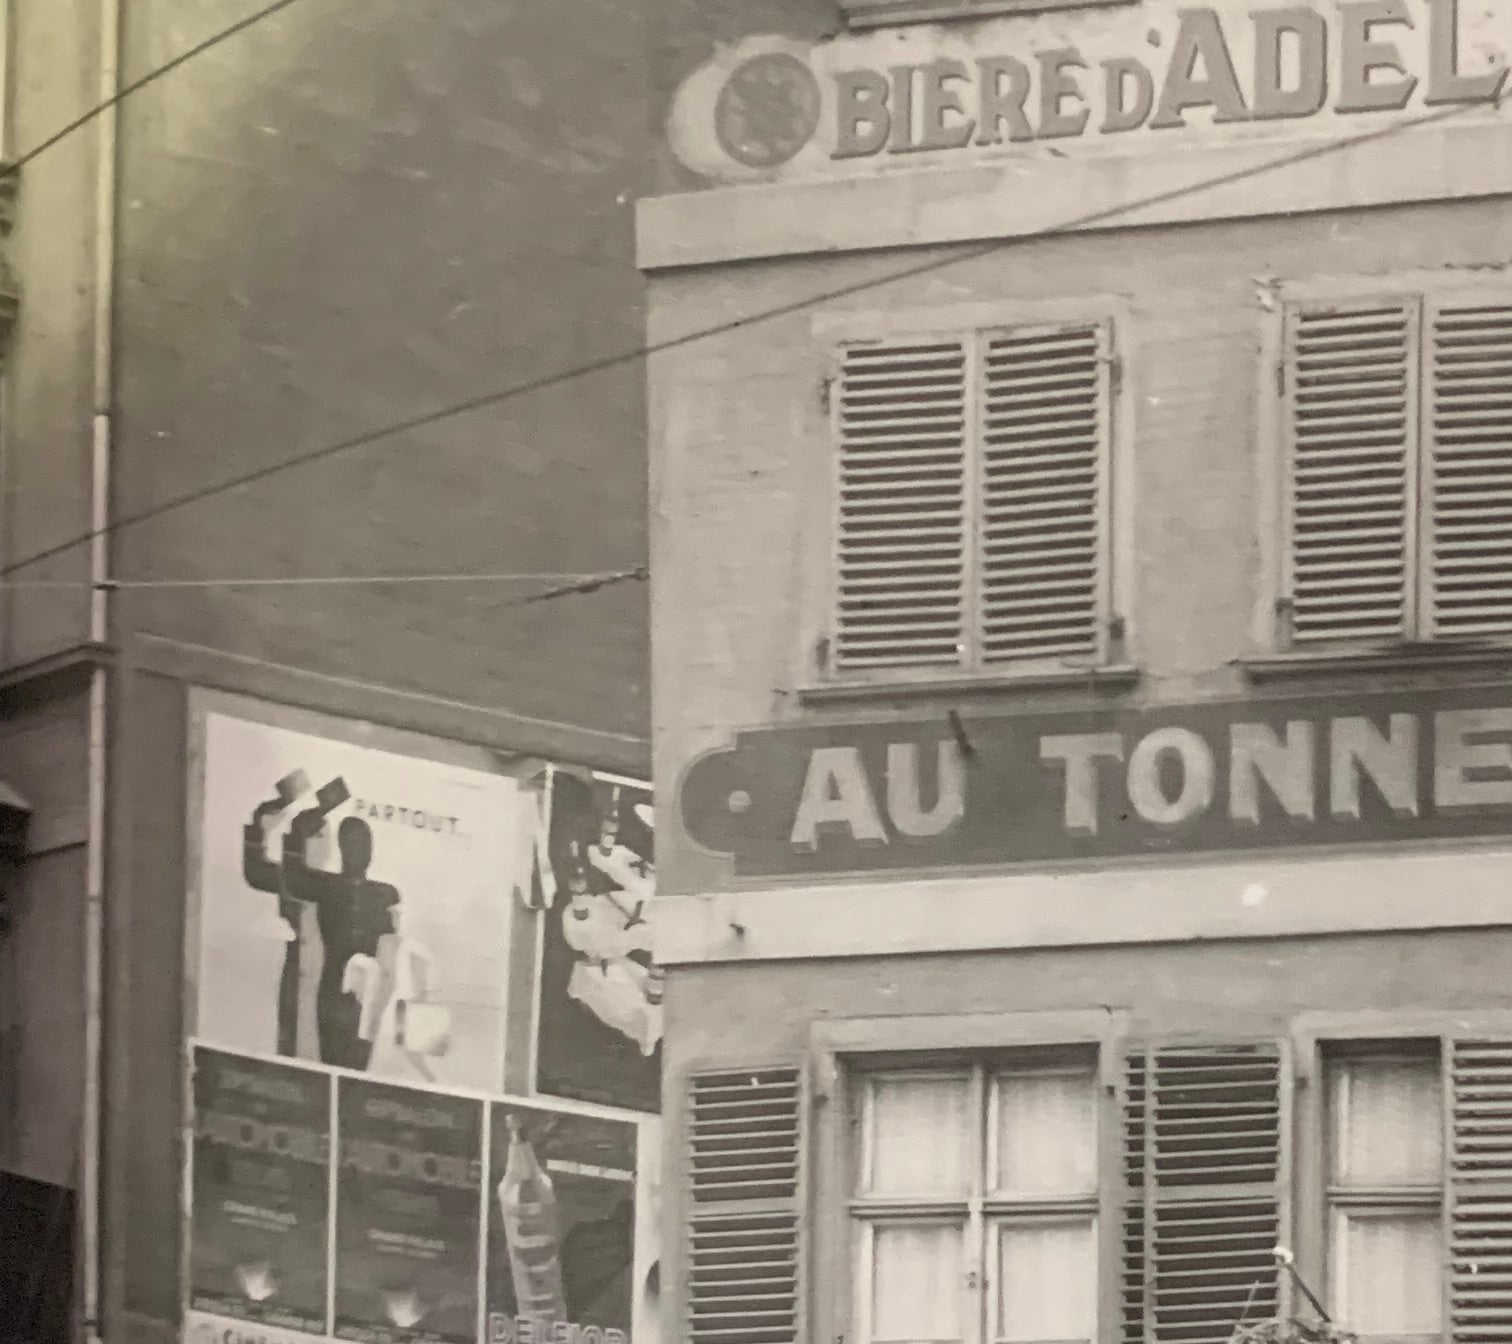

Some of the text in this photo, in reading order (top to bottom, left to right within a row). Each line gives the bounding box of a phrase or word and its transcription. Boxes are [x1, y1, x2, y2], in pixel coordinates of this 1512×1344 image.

[830, 46, 1090, 160] BIERE
[356, 798, 459, 834] PARTOUT
[790, 739, 968, 852] AU
